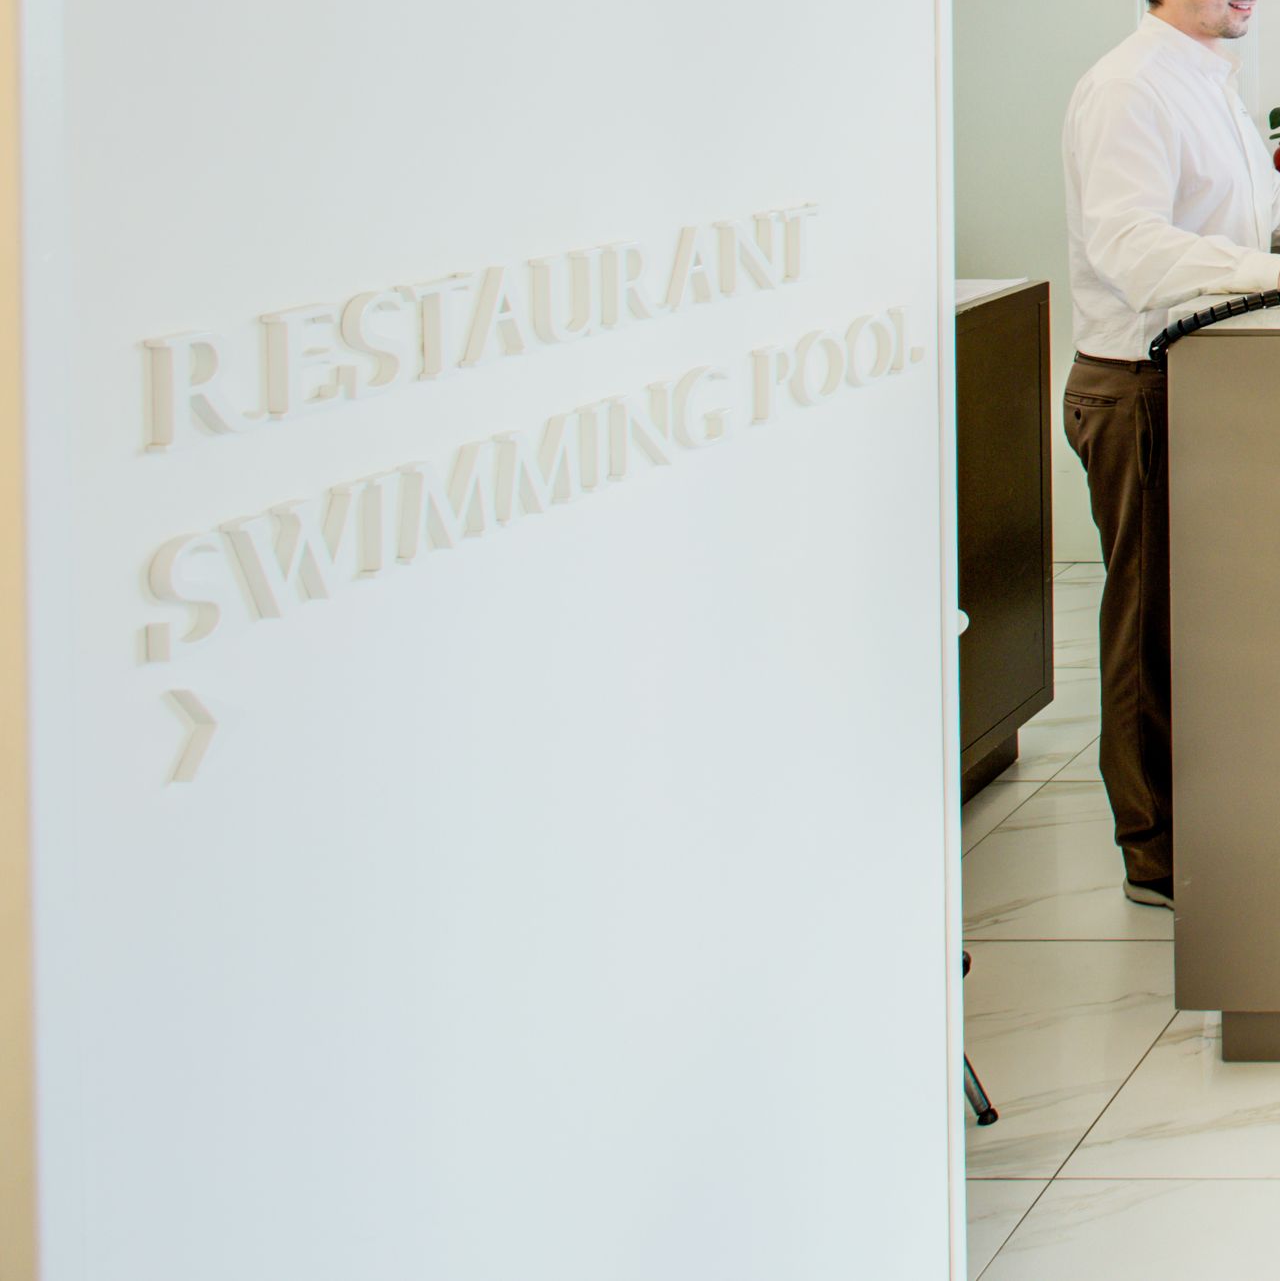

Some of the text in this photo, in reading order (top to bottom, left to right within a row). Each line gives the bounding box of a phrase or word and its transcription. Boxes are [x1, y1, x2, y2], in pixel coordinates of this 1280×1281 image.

[141, 203, 818, 454] RESTAURANT
[143, 305, 925, 663] SWIMMING POOL
